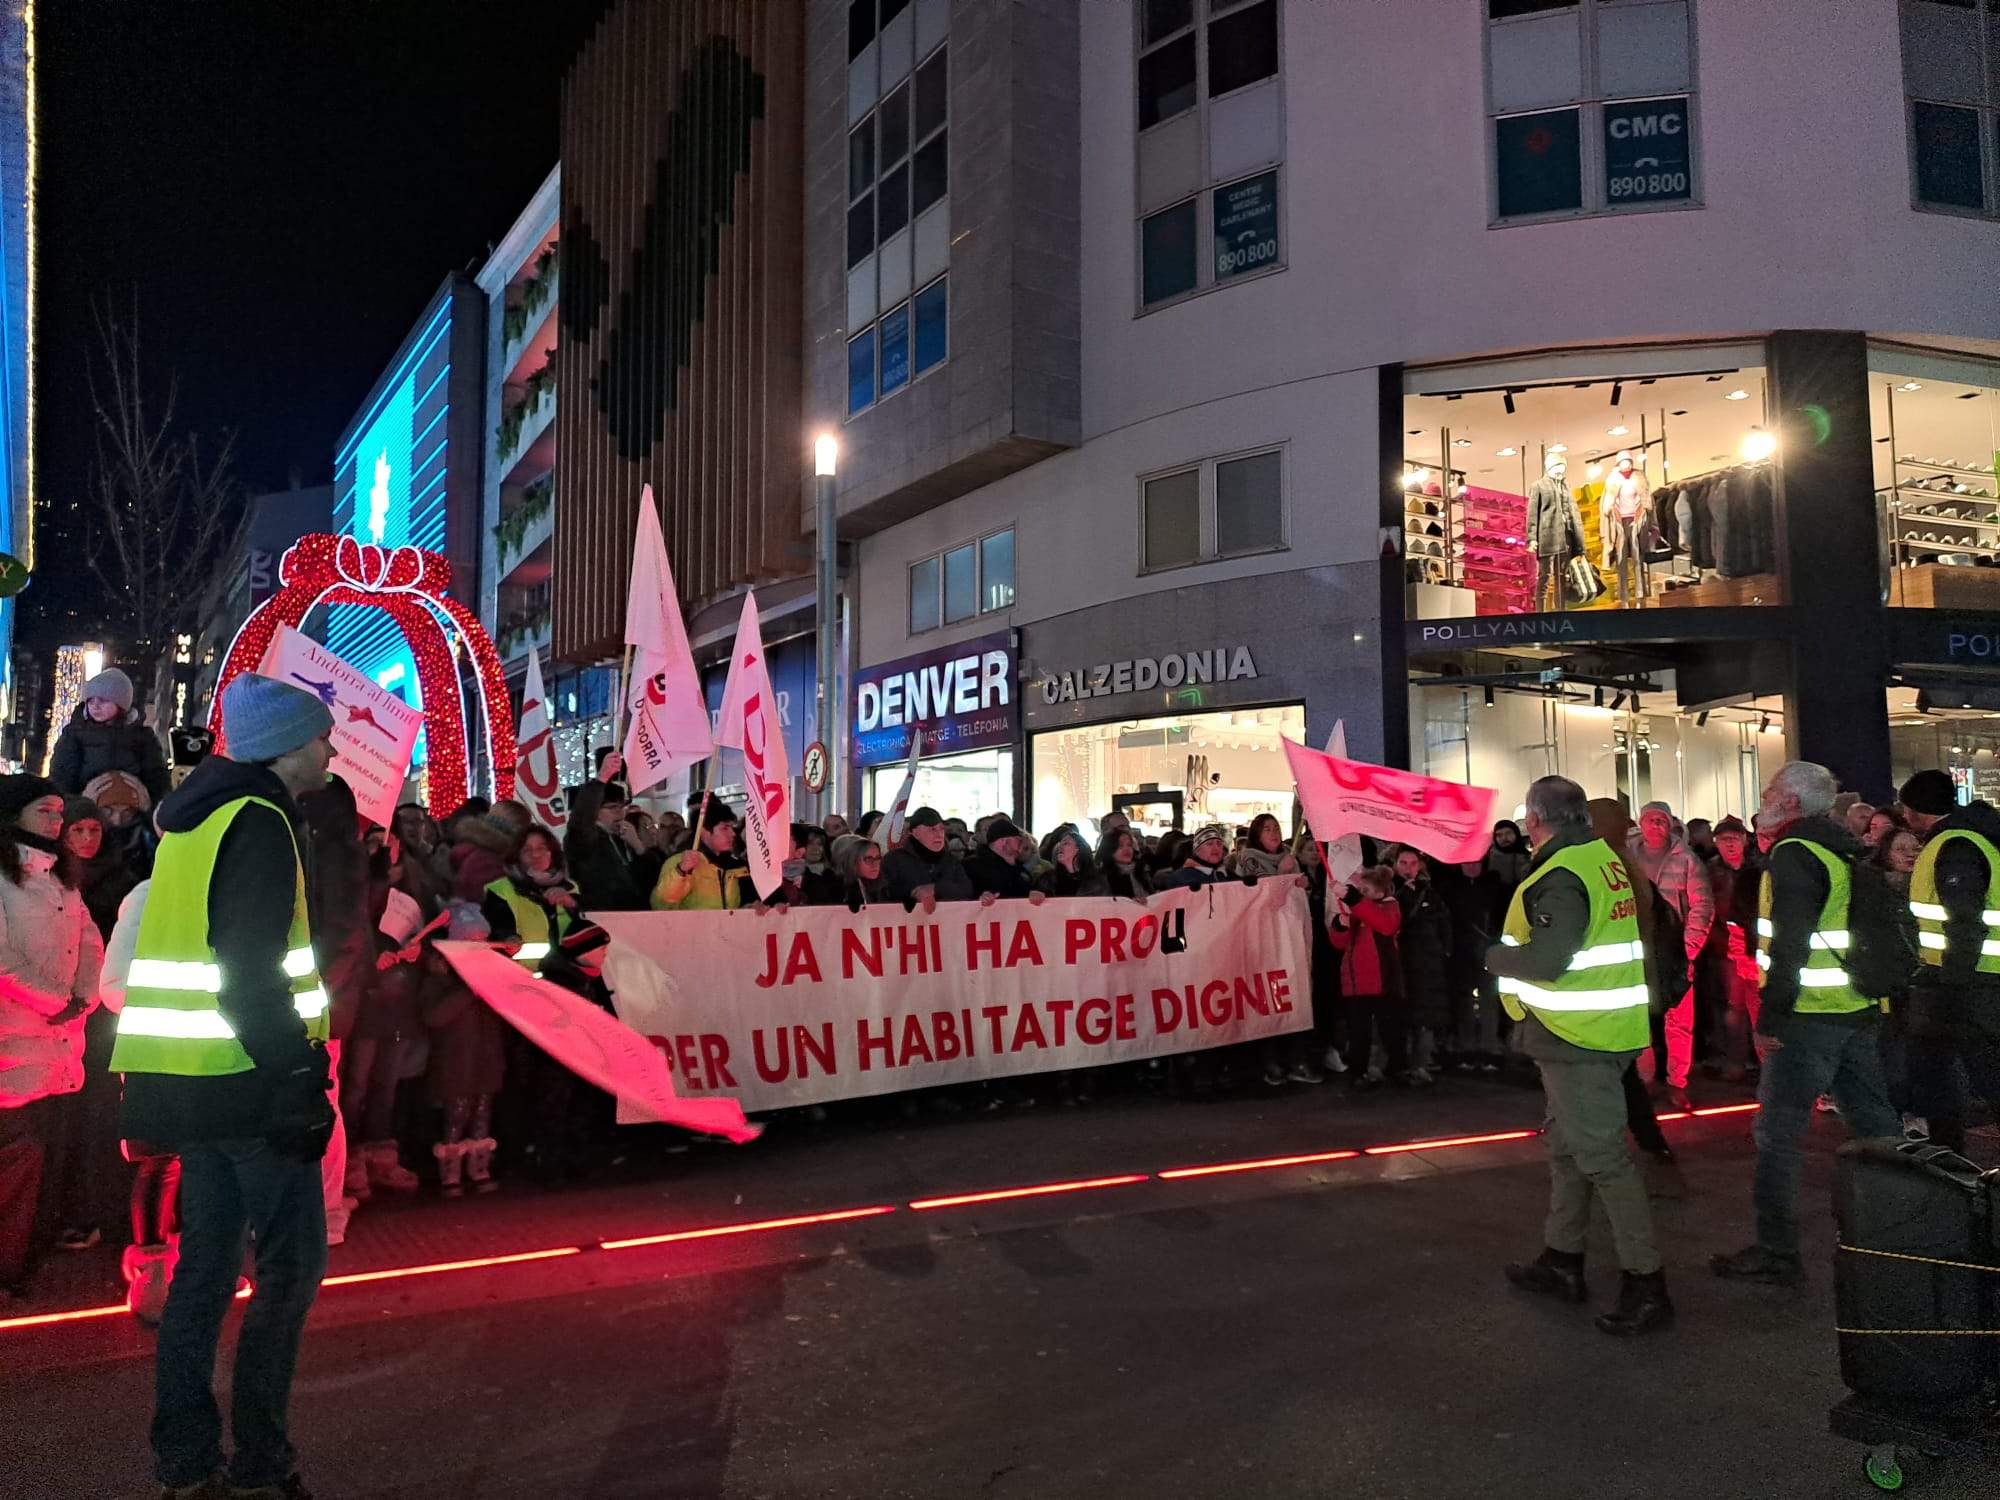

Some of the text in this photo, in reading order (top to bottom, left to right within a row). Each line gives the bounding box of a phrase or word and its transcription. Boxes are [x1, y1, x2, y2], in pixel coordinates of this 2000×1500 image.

[1610, 113, 1681, 139] CMC
[1423, 619, 1575, 641] POLLYANNA
[302, 647, 365, 691] Andorra
[858, 650, 1009, 732] DENVER
[1042, 646, 1258, 705] CALZEDONIA
[755, 907, 1188, 988] JA N'HI HA PROU
[752, 1022, 837, 1084] UN
[857, 993, 1137, 1072] HABITATGE
[1152, 969, 1293, 1035] DIGNE
